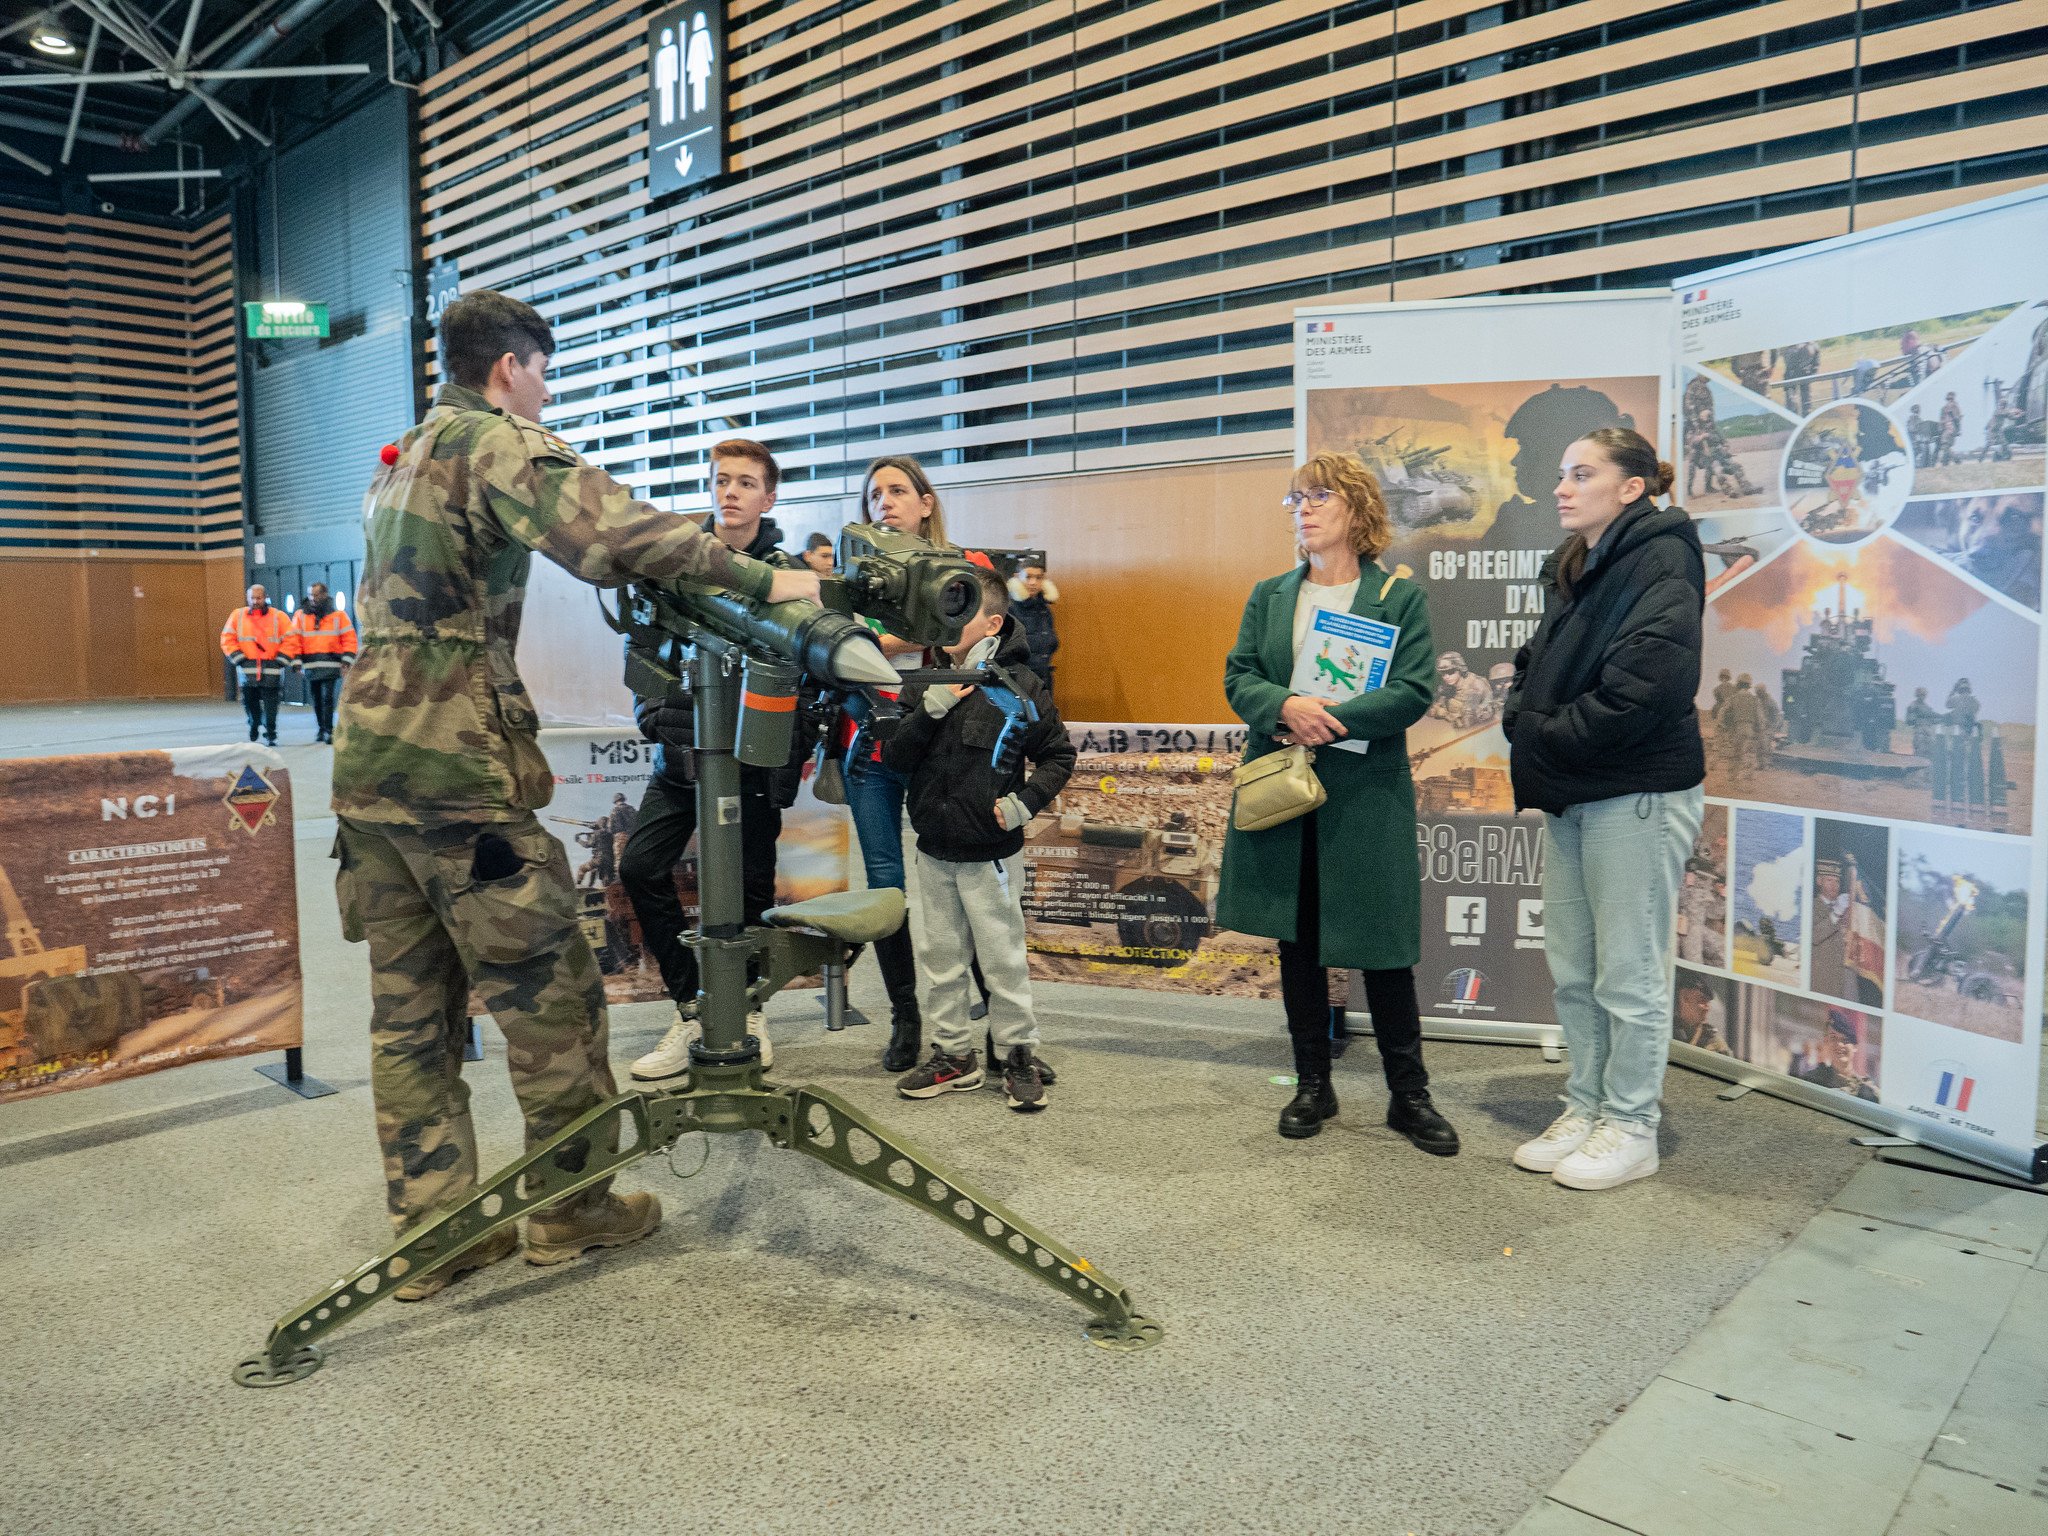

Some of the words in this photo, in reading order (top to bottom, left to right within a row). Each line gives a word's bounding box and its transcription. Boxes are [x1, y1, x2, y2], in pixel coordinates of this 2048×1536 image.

[262, 308, 315, 324] Sortie
[256, 324, 271, 336] de
[274, 325, 320, 336] secours
[1682, 318, 1700, 330] DES
[1305, 333, 1364, 346] MINISTÈRE
[1305, 348, 1326, 357] DES
[1328, 344, 1372, 356] ARMÉES
[1118, 760, 1135, 772] de
[100, 794, 176, 821] NC1
[68, 838, 207, 863] CARACTERISTIQUES
[1104, 945, 1193, 960] PROTECTION
[1964, 1121, 1996, 1137] TERRE
